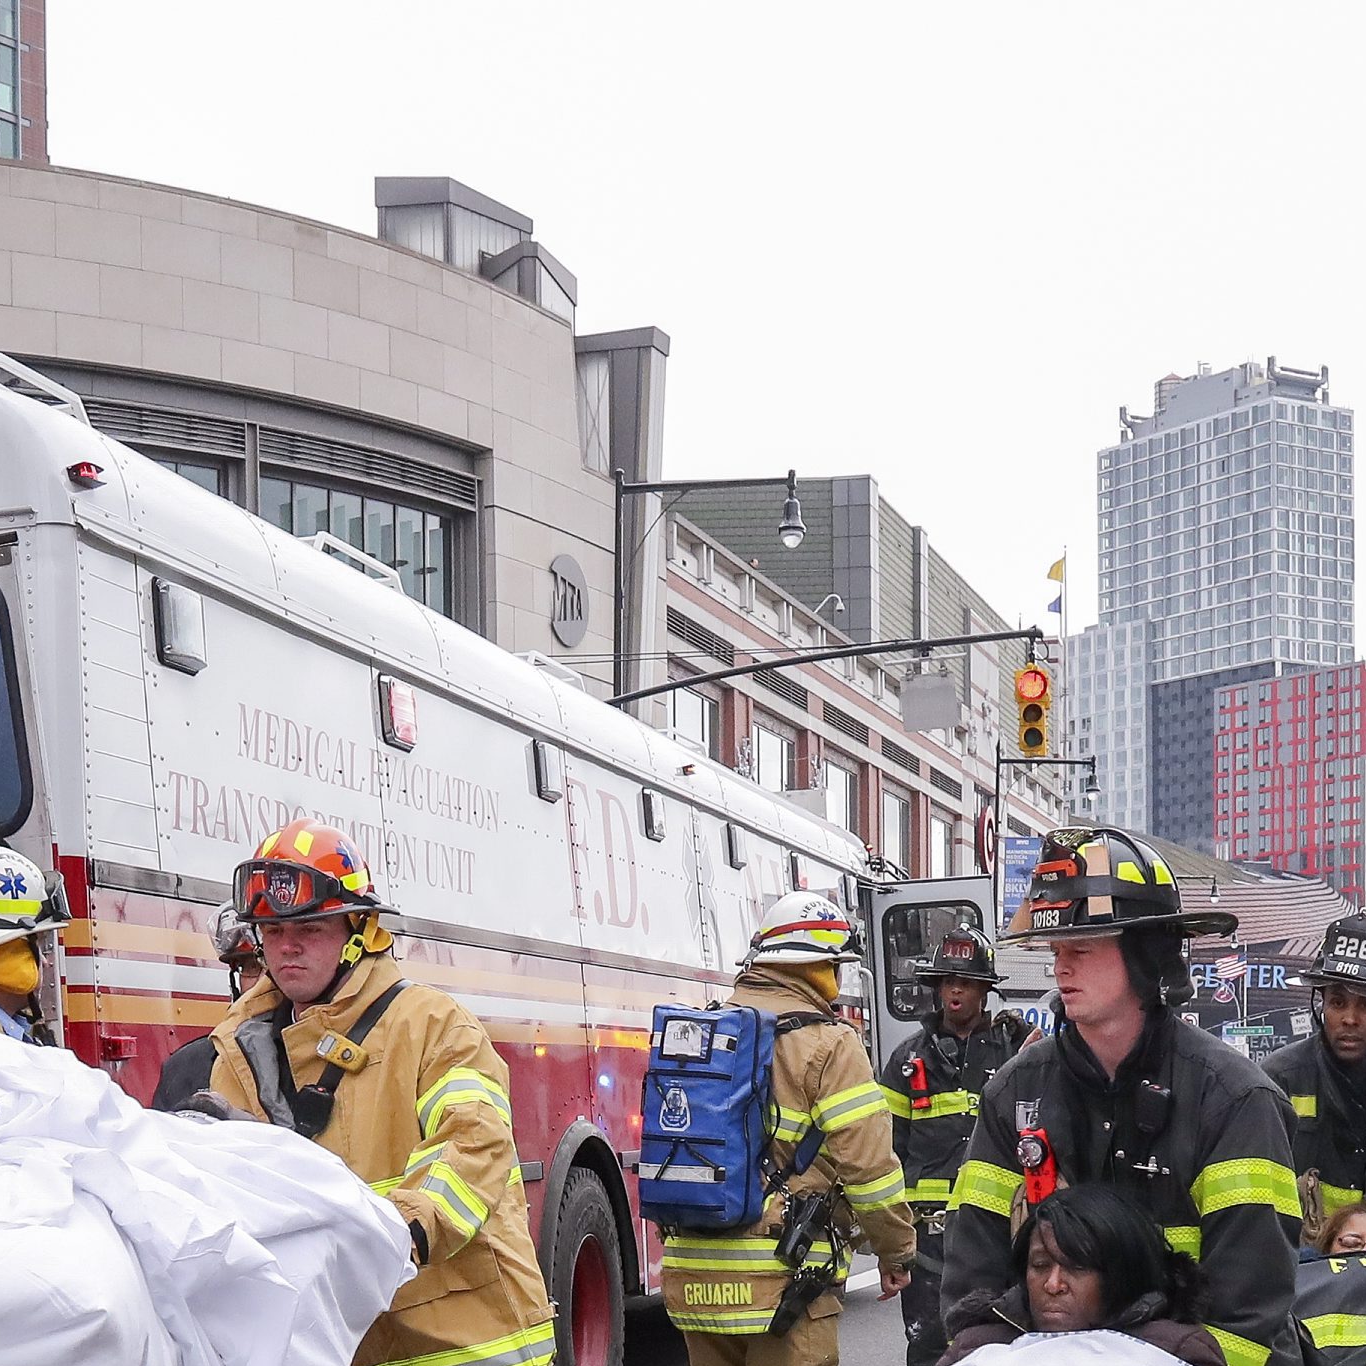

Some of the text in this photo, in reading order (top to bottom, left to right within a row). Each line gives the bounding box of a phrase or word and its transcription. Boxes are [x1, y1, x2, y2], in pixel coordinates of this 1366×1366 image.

[237, 703, 501, 833] MEDICAL EVACUATION
[423, 838, 477, 896] UNIT
[563, 776, 650, 936] F.D.
[1033, 909, 1060, 929] 10183
[1336, 962, 1360, 975] 8116
[684, 1282, 753, 1306] GRUARIN
